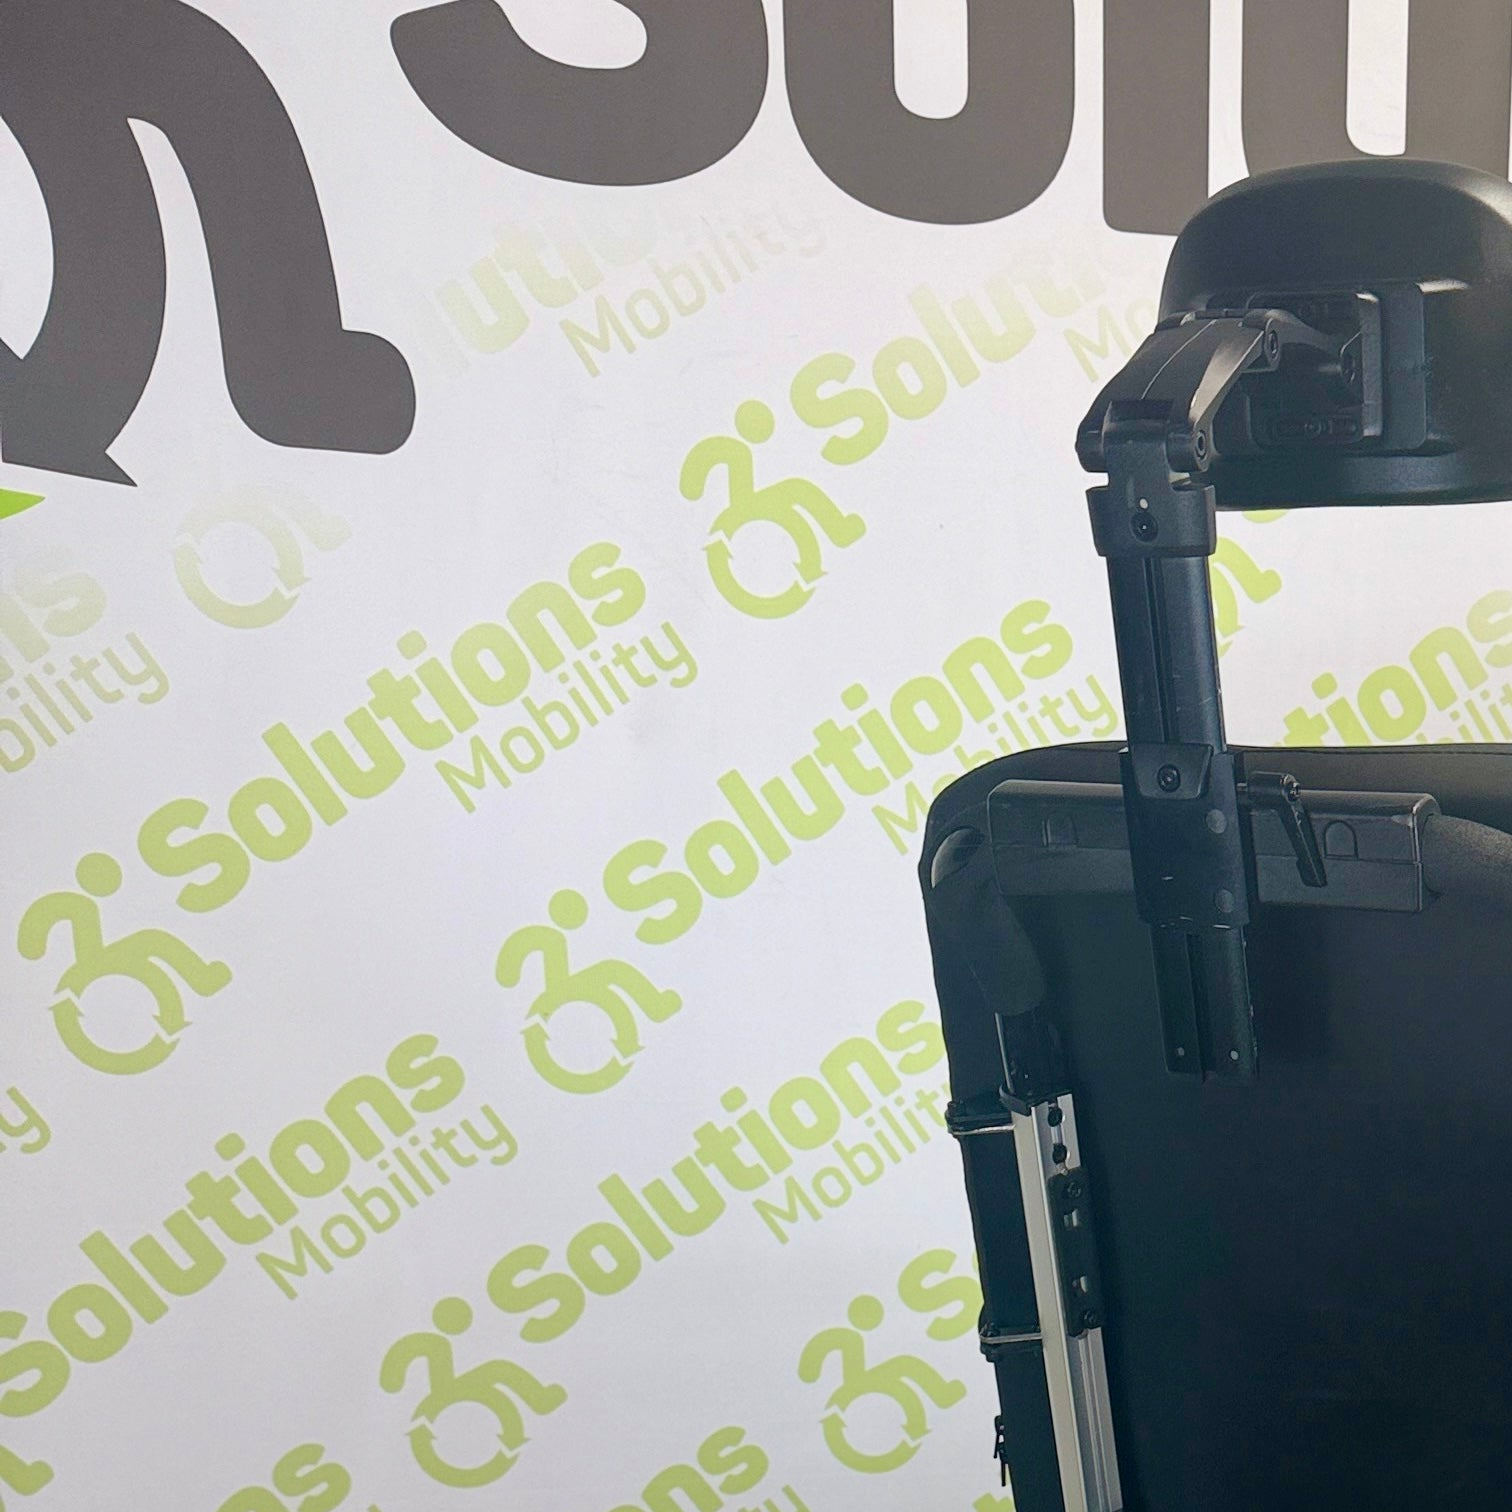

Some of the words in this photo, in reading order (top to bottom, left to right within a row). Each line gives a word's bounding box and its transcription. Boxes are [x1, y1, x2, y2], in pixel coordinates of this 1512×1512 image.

[0, 631, 169, 773] ility
[137, 541, 646, 914] Solutions
[434, 621, 698, 813] Mobility
[603, 599, 1074, 945] Solutions
[871, 674, 1118, 855] Mility
[255, 1104, 518, 1300] Mobility
[487, 1000, 945, 1343] Solutions
[752, 1081, 950, 1245] Mobilit
